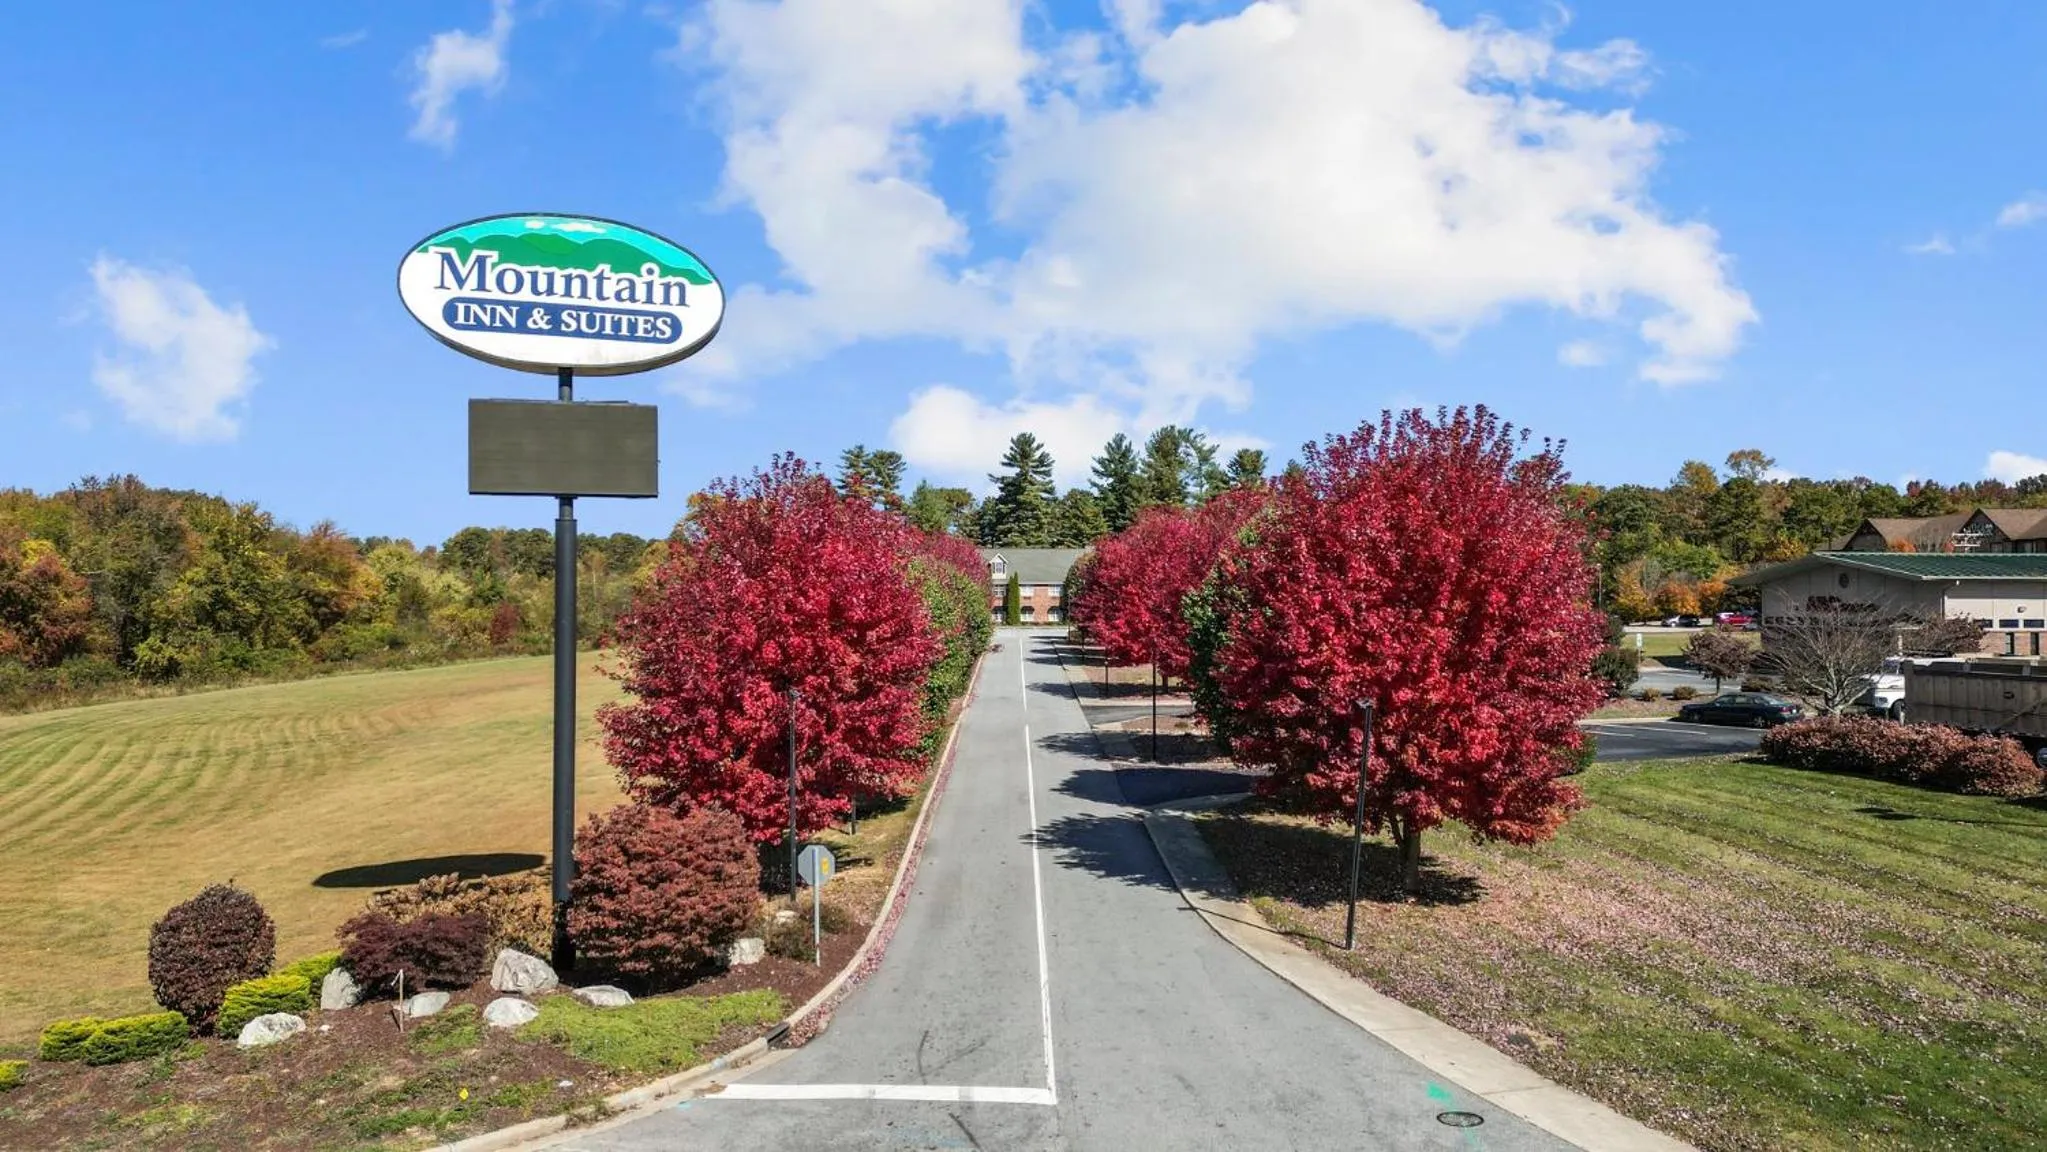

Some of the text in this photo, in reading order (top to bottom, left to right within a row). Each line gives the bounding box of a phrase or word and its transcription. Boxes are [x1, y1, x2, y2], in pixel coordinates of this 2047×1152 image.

[434, 251, 690, 307] Mountain
[454, 302, 672, 339] INN & SUITES
